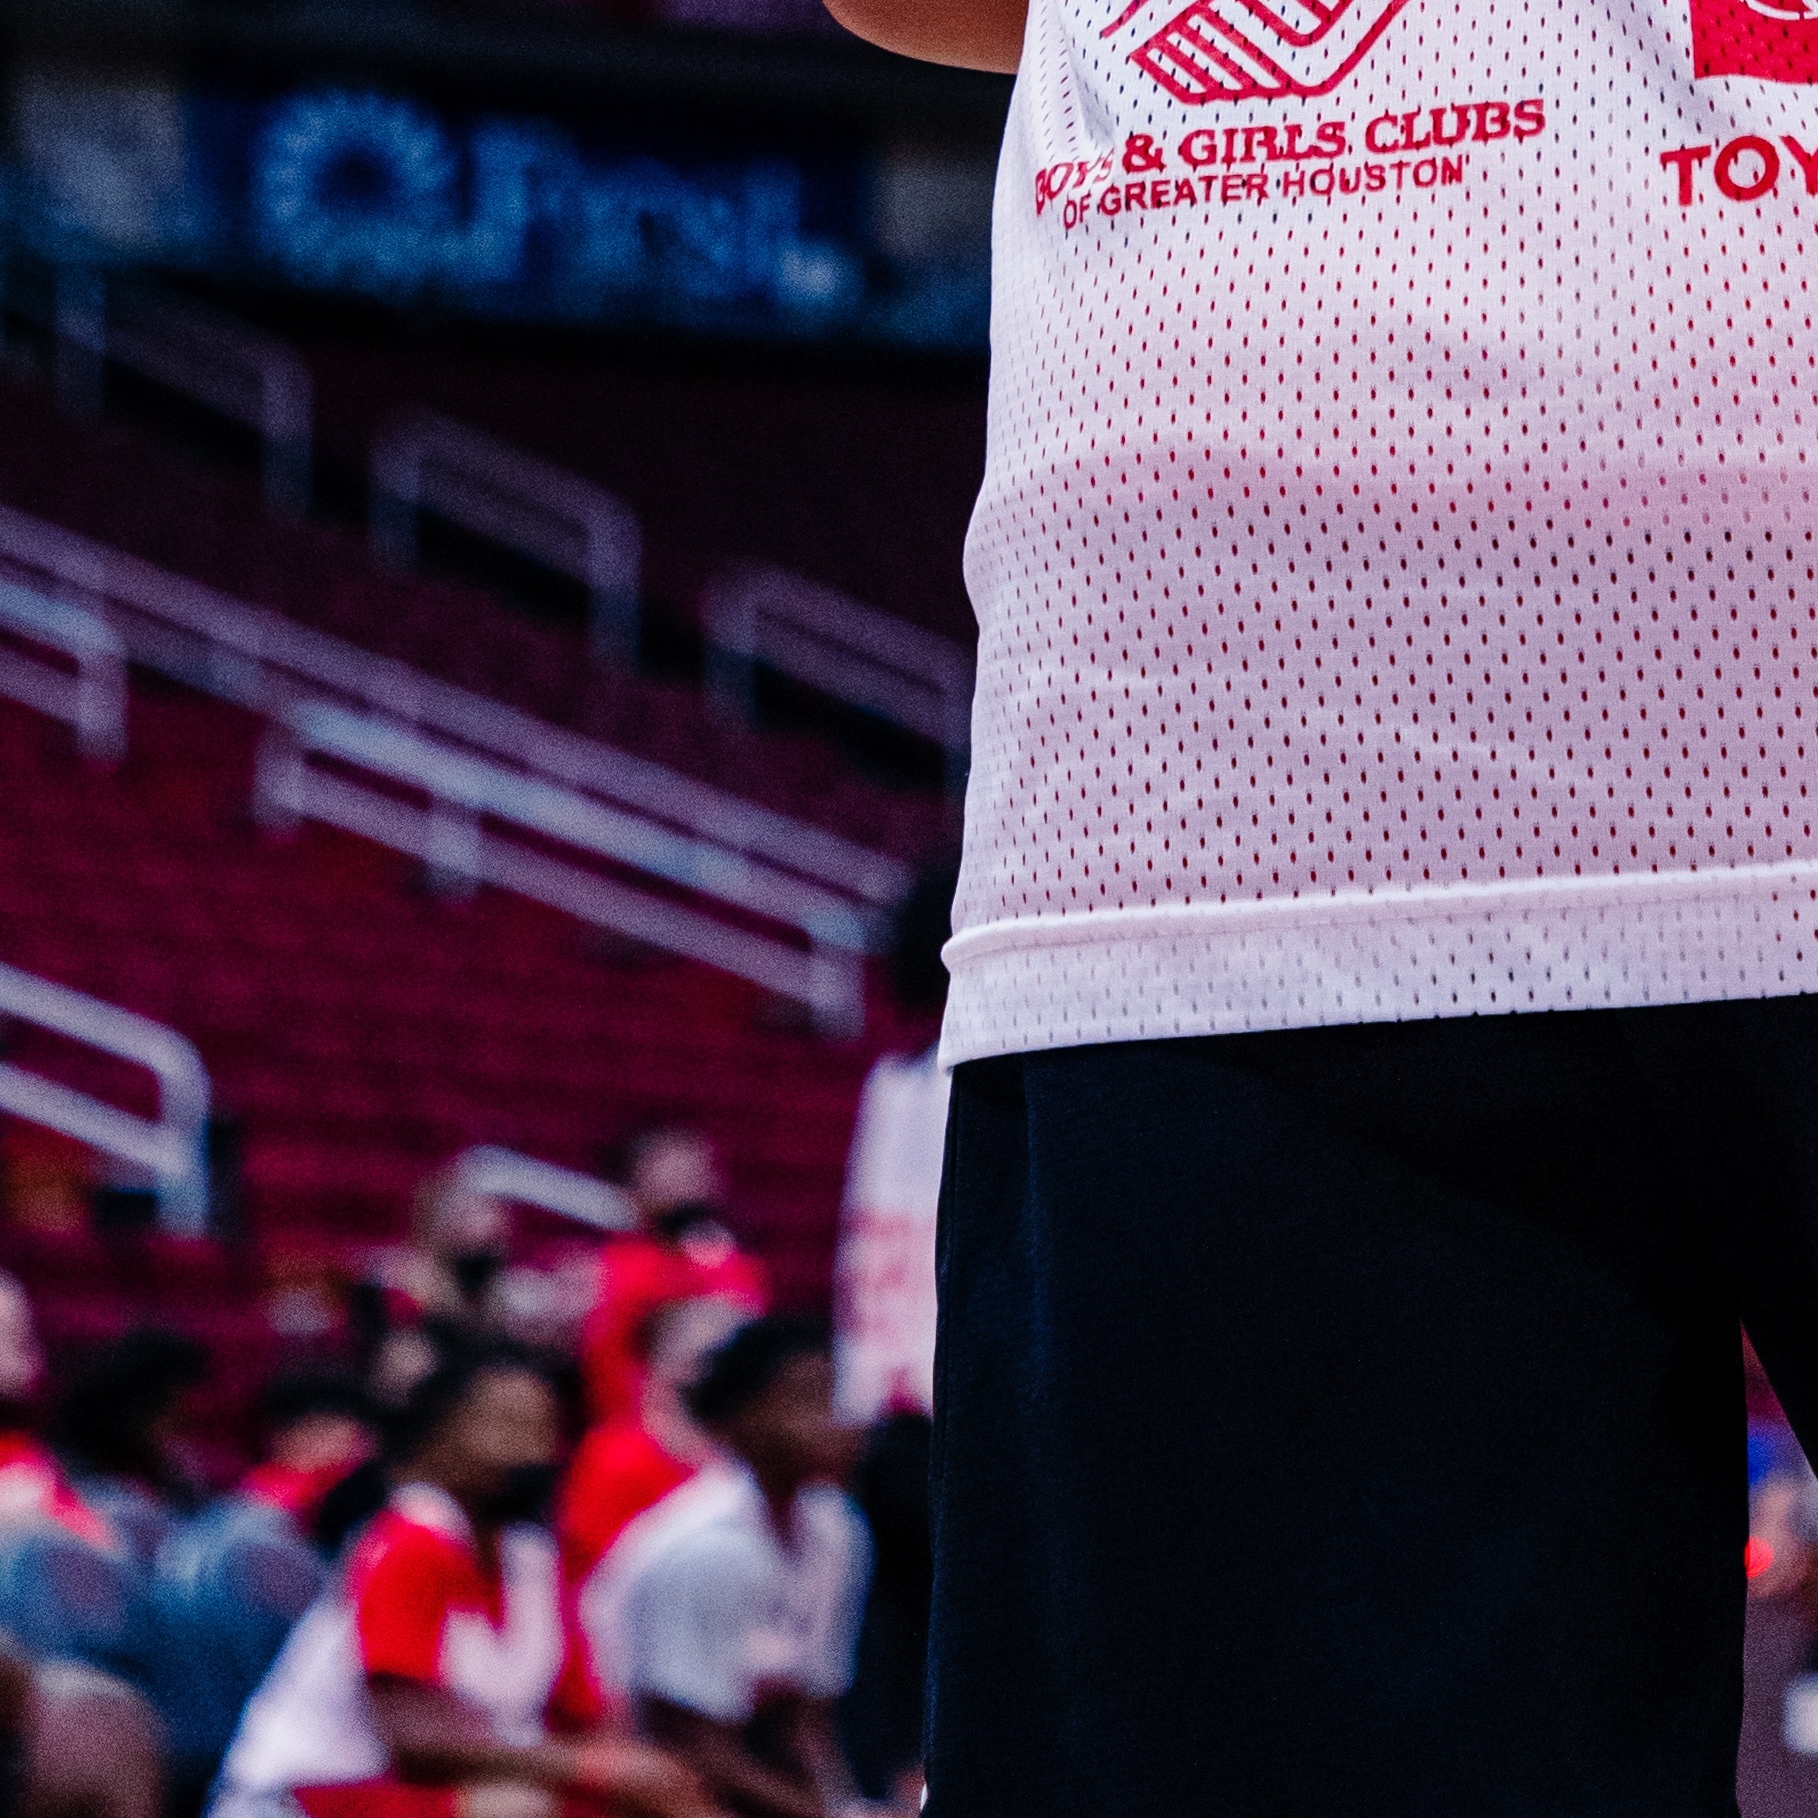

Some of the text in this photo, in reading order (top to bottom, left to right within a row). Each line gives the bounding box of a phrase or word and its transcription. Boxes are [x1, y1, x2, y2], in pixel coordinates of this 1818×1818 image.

[1122, 133, 1166, 173] &
[1178, 121, 1347, 167] GIRLS
[1364, 99, 1547, 155] CLUBS
[1063, 154, 1464, 230] OF GREATER HOUSTON
